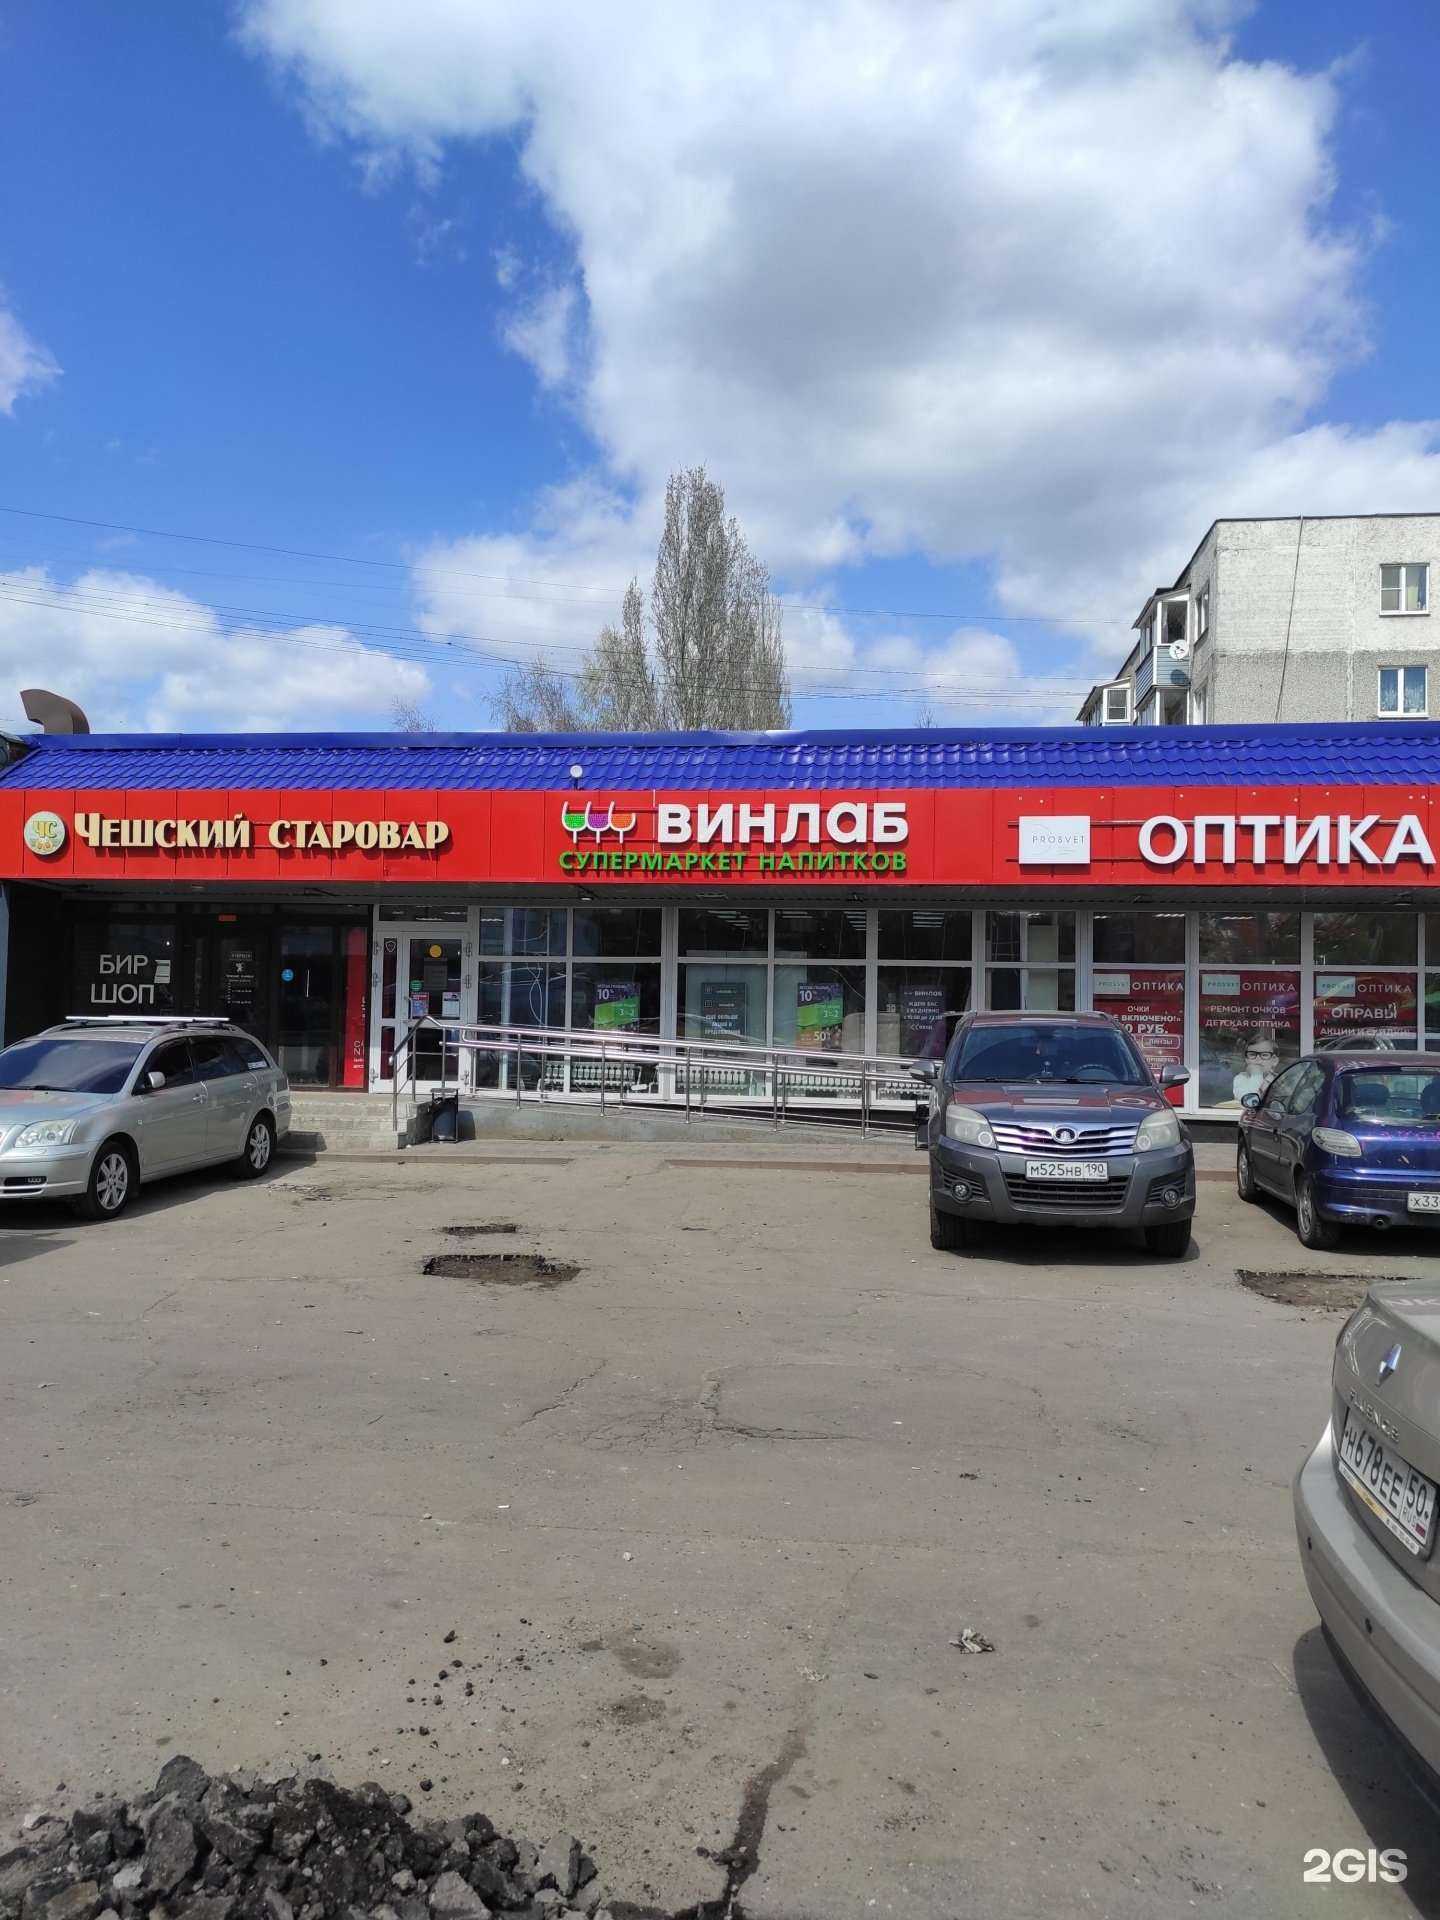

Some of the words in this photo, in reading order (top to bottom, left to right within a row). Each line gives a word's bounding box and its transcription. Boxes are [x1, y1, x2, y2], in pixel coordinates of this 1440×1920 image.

[268, 819, 449, 849] СТАРОВАР
[1138, 815, 1437, 865] ОПТИКА
[559, 851, 747, 871] СУПЕРМАРКЕТ
[759, 851, 907, 871] НАПИТКОВ
[99, 954, 149, 975] БИР
[1131, 982, 1184, 992] ОПТИКА
[1242, 982, 1296, 992] ОПТИКА
[1357, 984, 1413, 993] ОПТИКА
[90, 983, 155, 1004] ШОП
[1127, 1005, 1150, 1013] ОЧКИ
[1210, 1005, 1250, 1013] РЕМОНТ
[1252, 1006, 1287, 1014] ОЧКОВ
[1331, 1007, 1397, 1019] ОПРАВЫ
[1137, 1023, 1169, 1034] РУБ.
[1205, 1019, 1249, 1028] ДЕТСКАЯ
[1251, 1020, 1291, 1028] ОПТИКА
[1320, 1027, 1355, 1037] АКЦИИ
[1085, 1163, 1104, 1175] 190
[1412, 1195, 1440, 1208] Х33
[1406, 1473, 1428, 1518] 50
